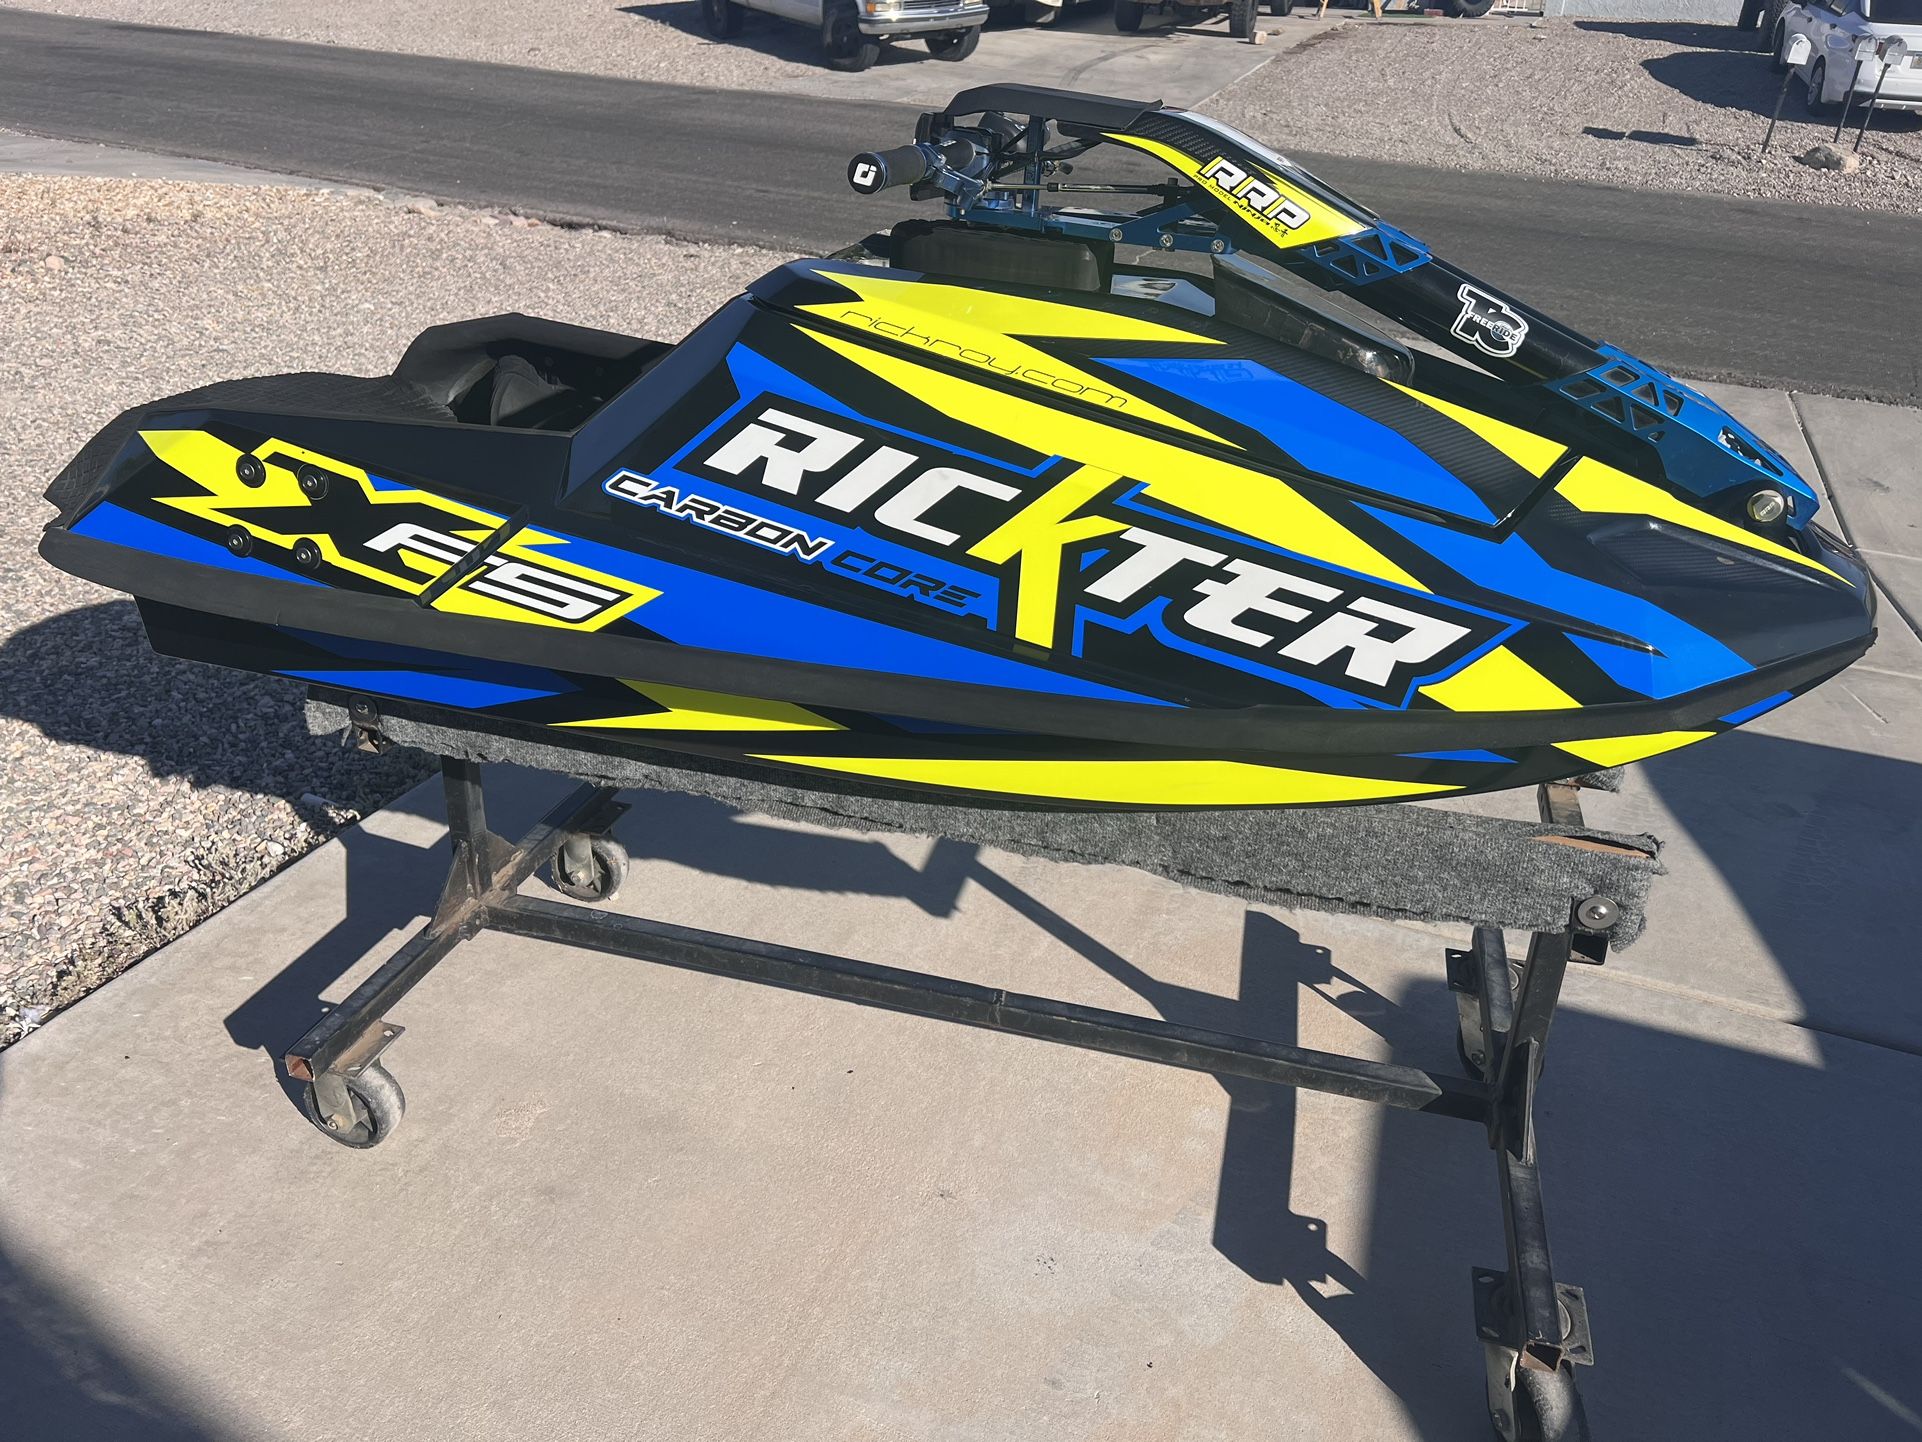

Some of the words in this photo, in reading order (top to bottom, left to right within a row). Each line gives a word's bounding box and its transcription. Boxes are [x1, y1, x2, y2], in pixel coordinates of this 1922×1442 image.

[1198, 155, 1311, 230] RRP
[840, 310, 1128, 408] rickroy.com
[1467, 312, 1518, 342] FREERIDE
[605, 470, 835, 560] CARBON
[830, 549, 983, 609] CORE
[703, 407, 1472, 687] RICKTER
